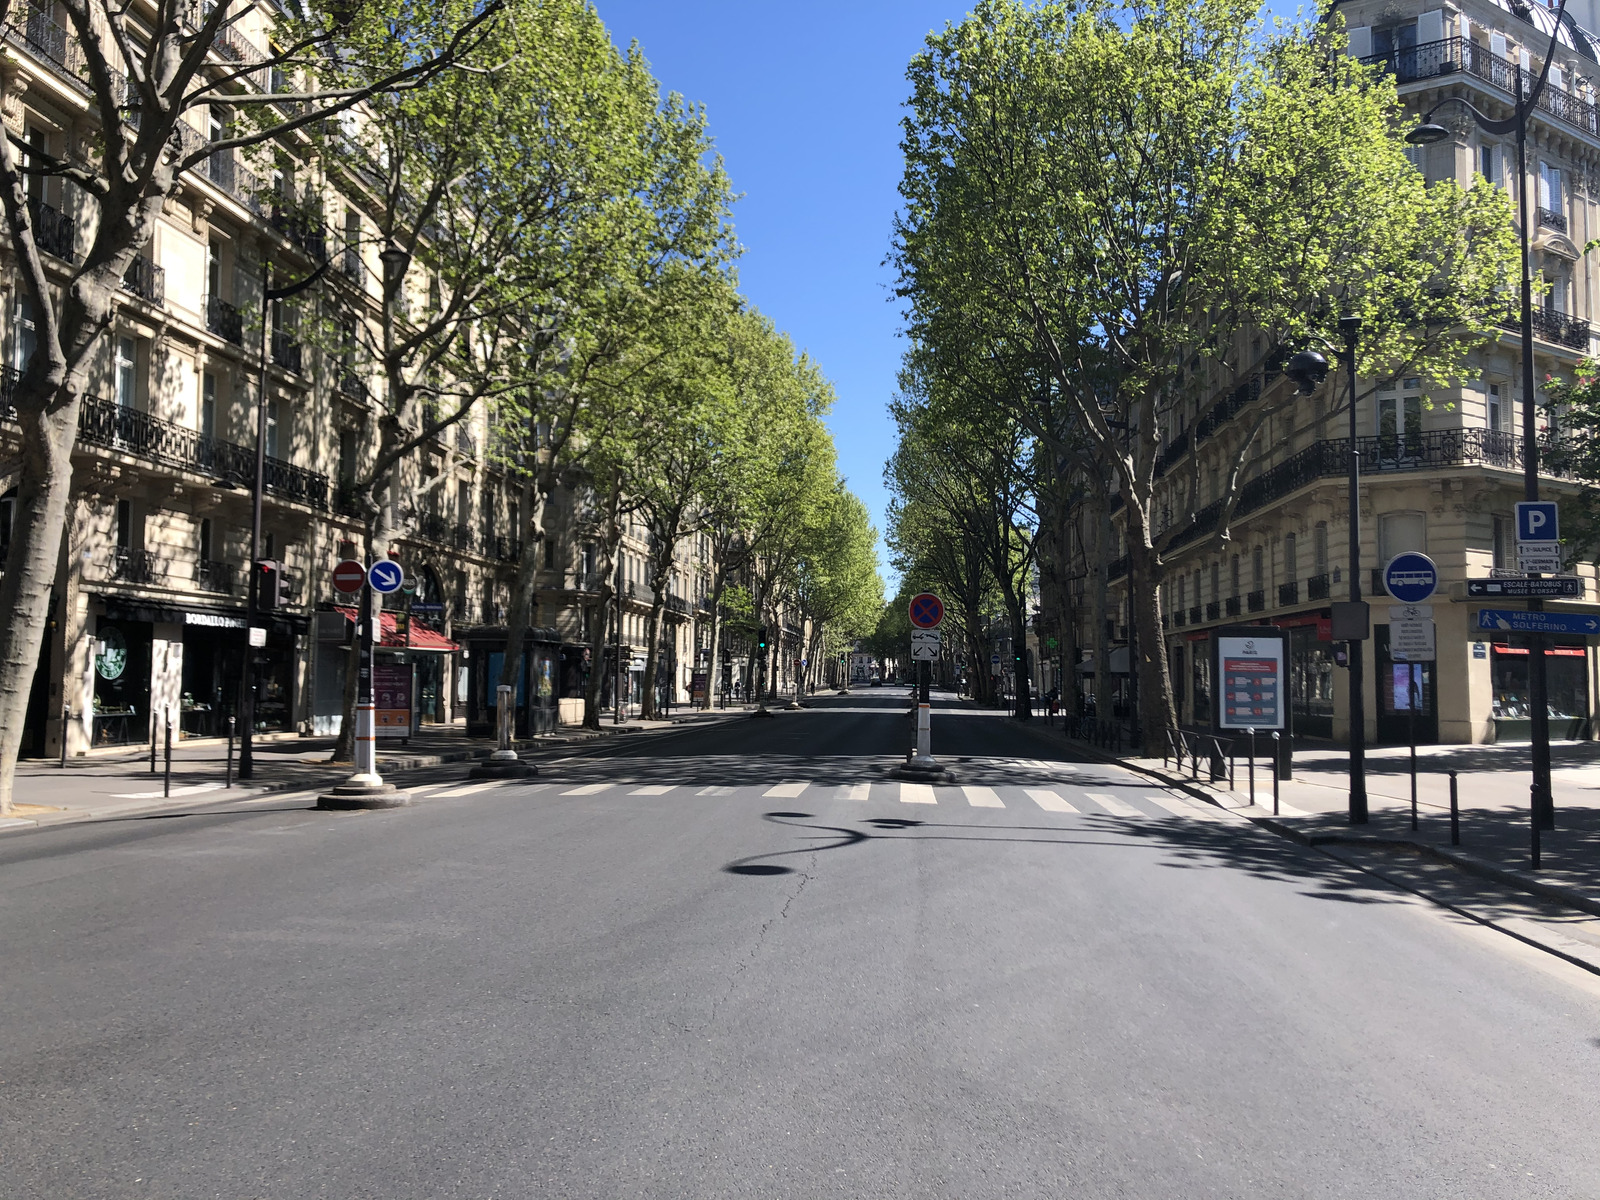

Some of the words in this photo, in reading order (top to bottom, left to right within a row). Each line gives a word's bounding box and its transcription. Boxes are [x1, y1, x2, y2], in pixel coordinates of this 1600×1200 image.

[1528, 510, 1546, 534] P
[1503, 580, 1562, 588] ESCALE-BATOBUS
[1512, 621, 1567, 631] SOLFERINO
